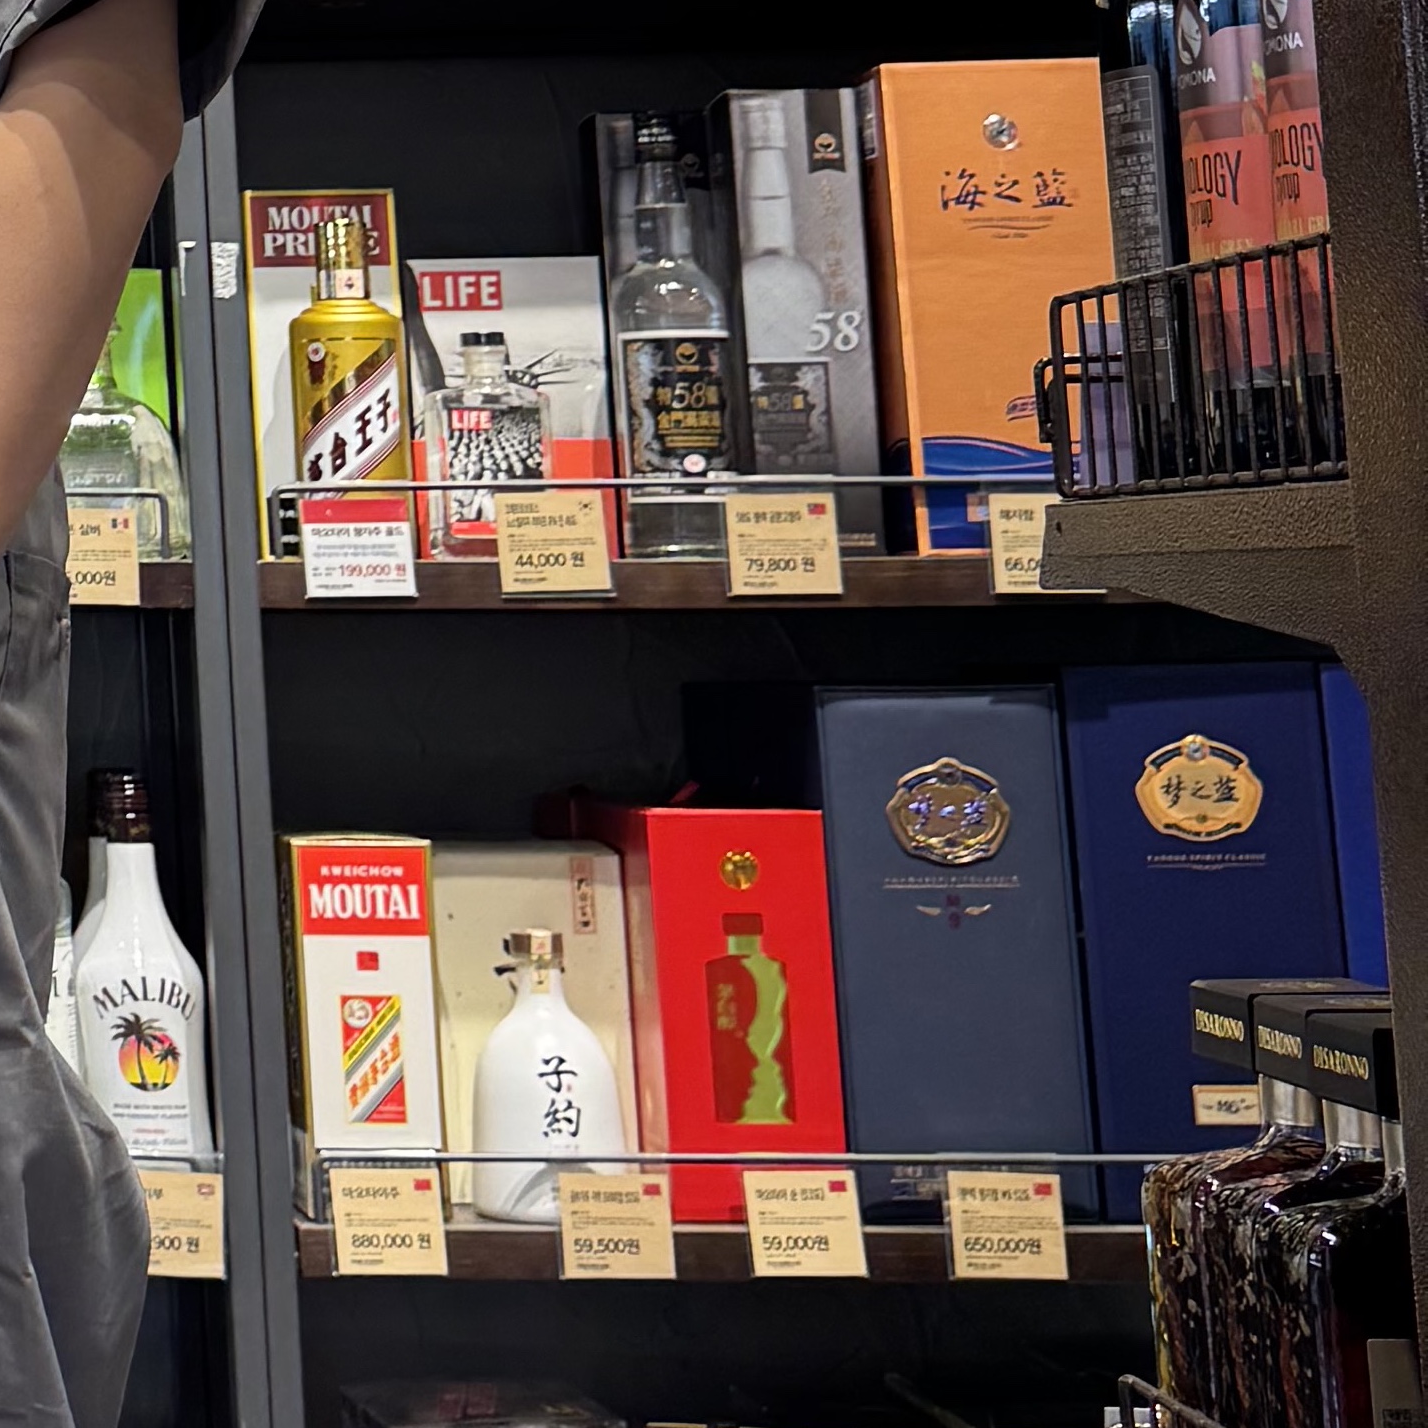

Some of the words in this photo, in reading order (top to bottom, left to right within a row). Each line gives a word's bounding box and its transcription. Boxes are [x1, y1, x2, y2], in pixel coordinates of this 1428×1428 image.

[423, 274, 502, 307] LIFE
[808, 311, 864, 352] 58
[451, 409, 491, 430] LIFE
[515, 552, 567, 568] 44,000
[571, 551, 586, 568] 원
[745, 557, 797, 572] 79,800
[338, 562, 391, 578] 199,000
[320, 866, 404, 878] KWEICHOW
[308, 884, 420, 921] MOUTAI
[91, 976, 199, 1020] MALIBU
[1194, 1008, 1245, 1043] DISARONNO
[1256, 1024, 1303, 1060] DISARONNO
[1313, 1044, 1370, 1082] DISARONNO
[417, 1233, 432, 1250] 원
[573, 1236, 641, 1254] 59,500원
[762, 1234, 830, 1252] 59,000원
[963, 1237, 1043, 1255] 650,000원
